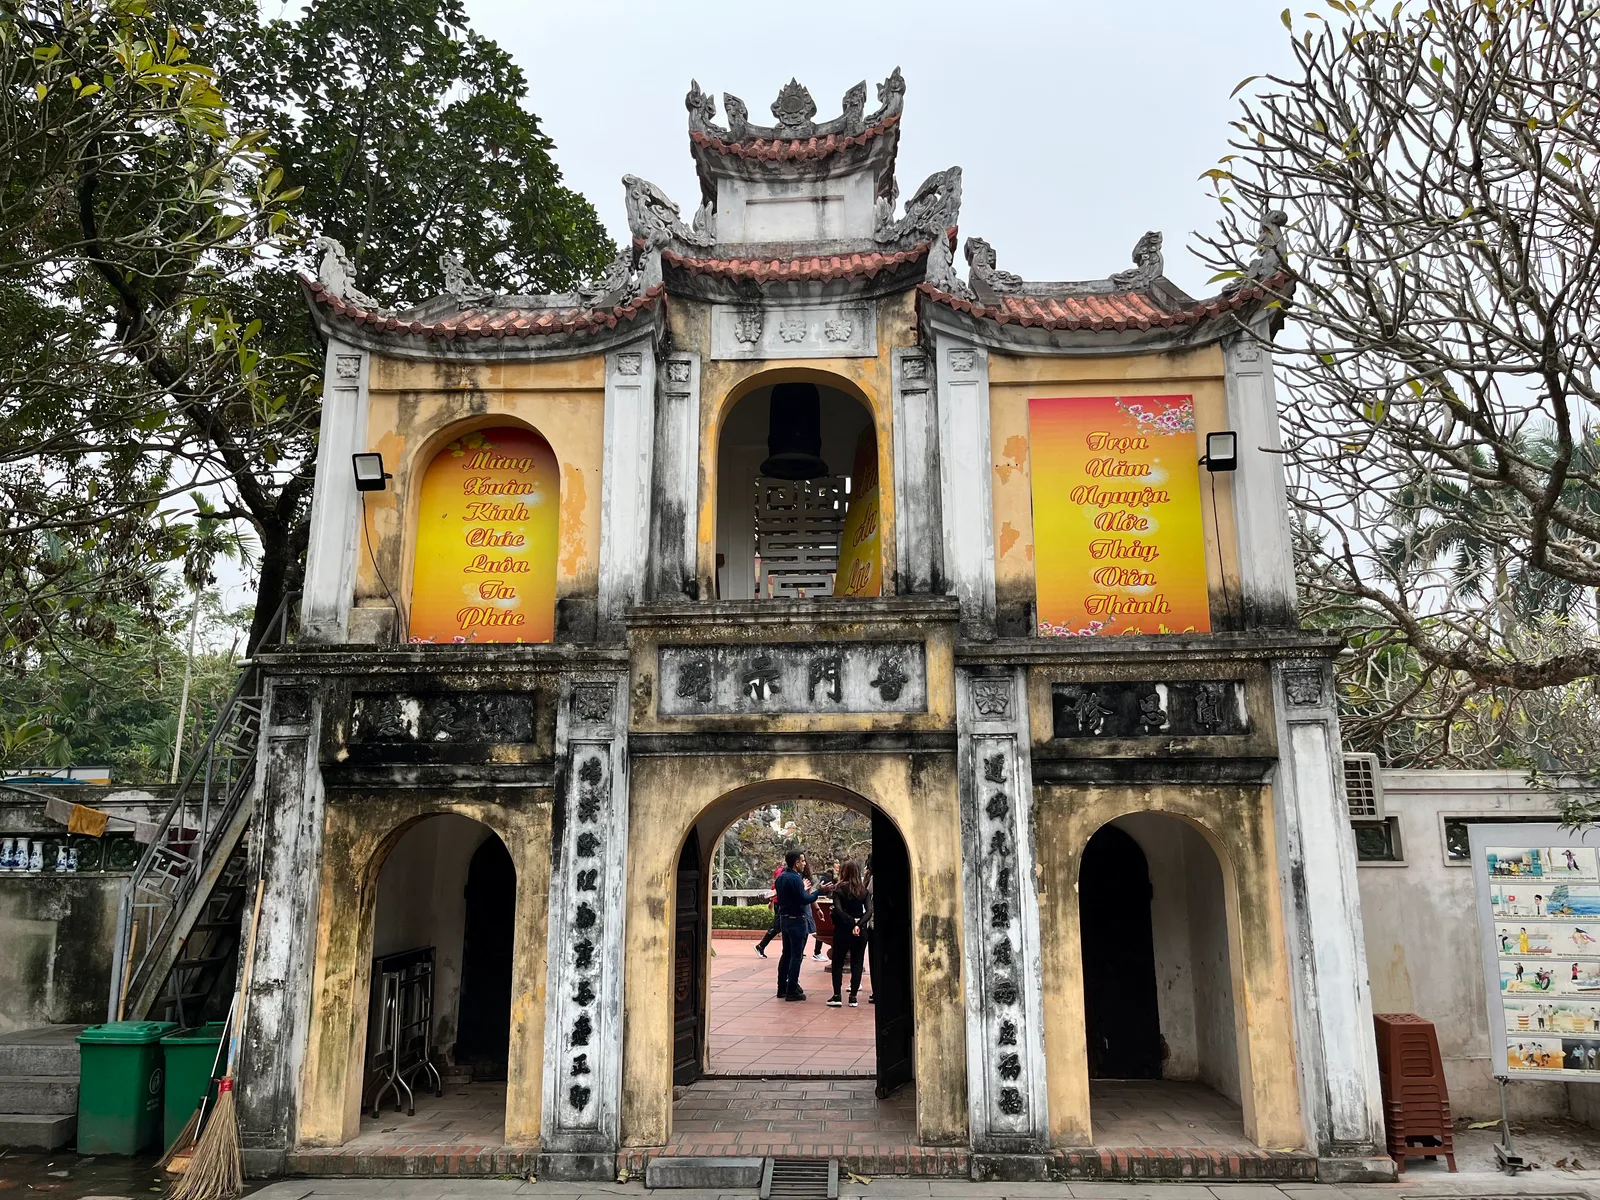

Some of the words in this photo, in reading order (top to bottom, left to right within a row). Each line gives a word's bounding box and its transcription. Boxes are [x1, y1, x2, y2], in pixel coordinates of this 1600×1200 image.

[1086, 431, 1149, 454] Trọn
[462, 450, 535, 473] Mừng
[1085, 458, 1152, 478] Năm
[463, 476, 534, 496] Xuân
[1070, 485, 1170, 509] Nguyện
[1094, 510, 1149, 532] Ước
[465, 527, 525, 547] Chúc
[1089, 538, 1160, 562] Thảy
[463, 554, 531, 574] Luôn
[1094, 566, 1157, 587] Viên
[479, 580, 516, 600] Tu
[1084, 594, 1171, 615] Thành
[457, 606, 525, 630] Phúc
